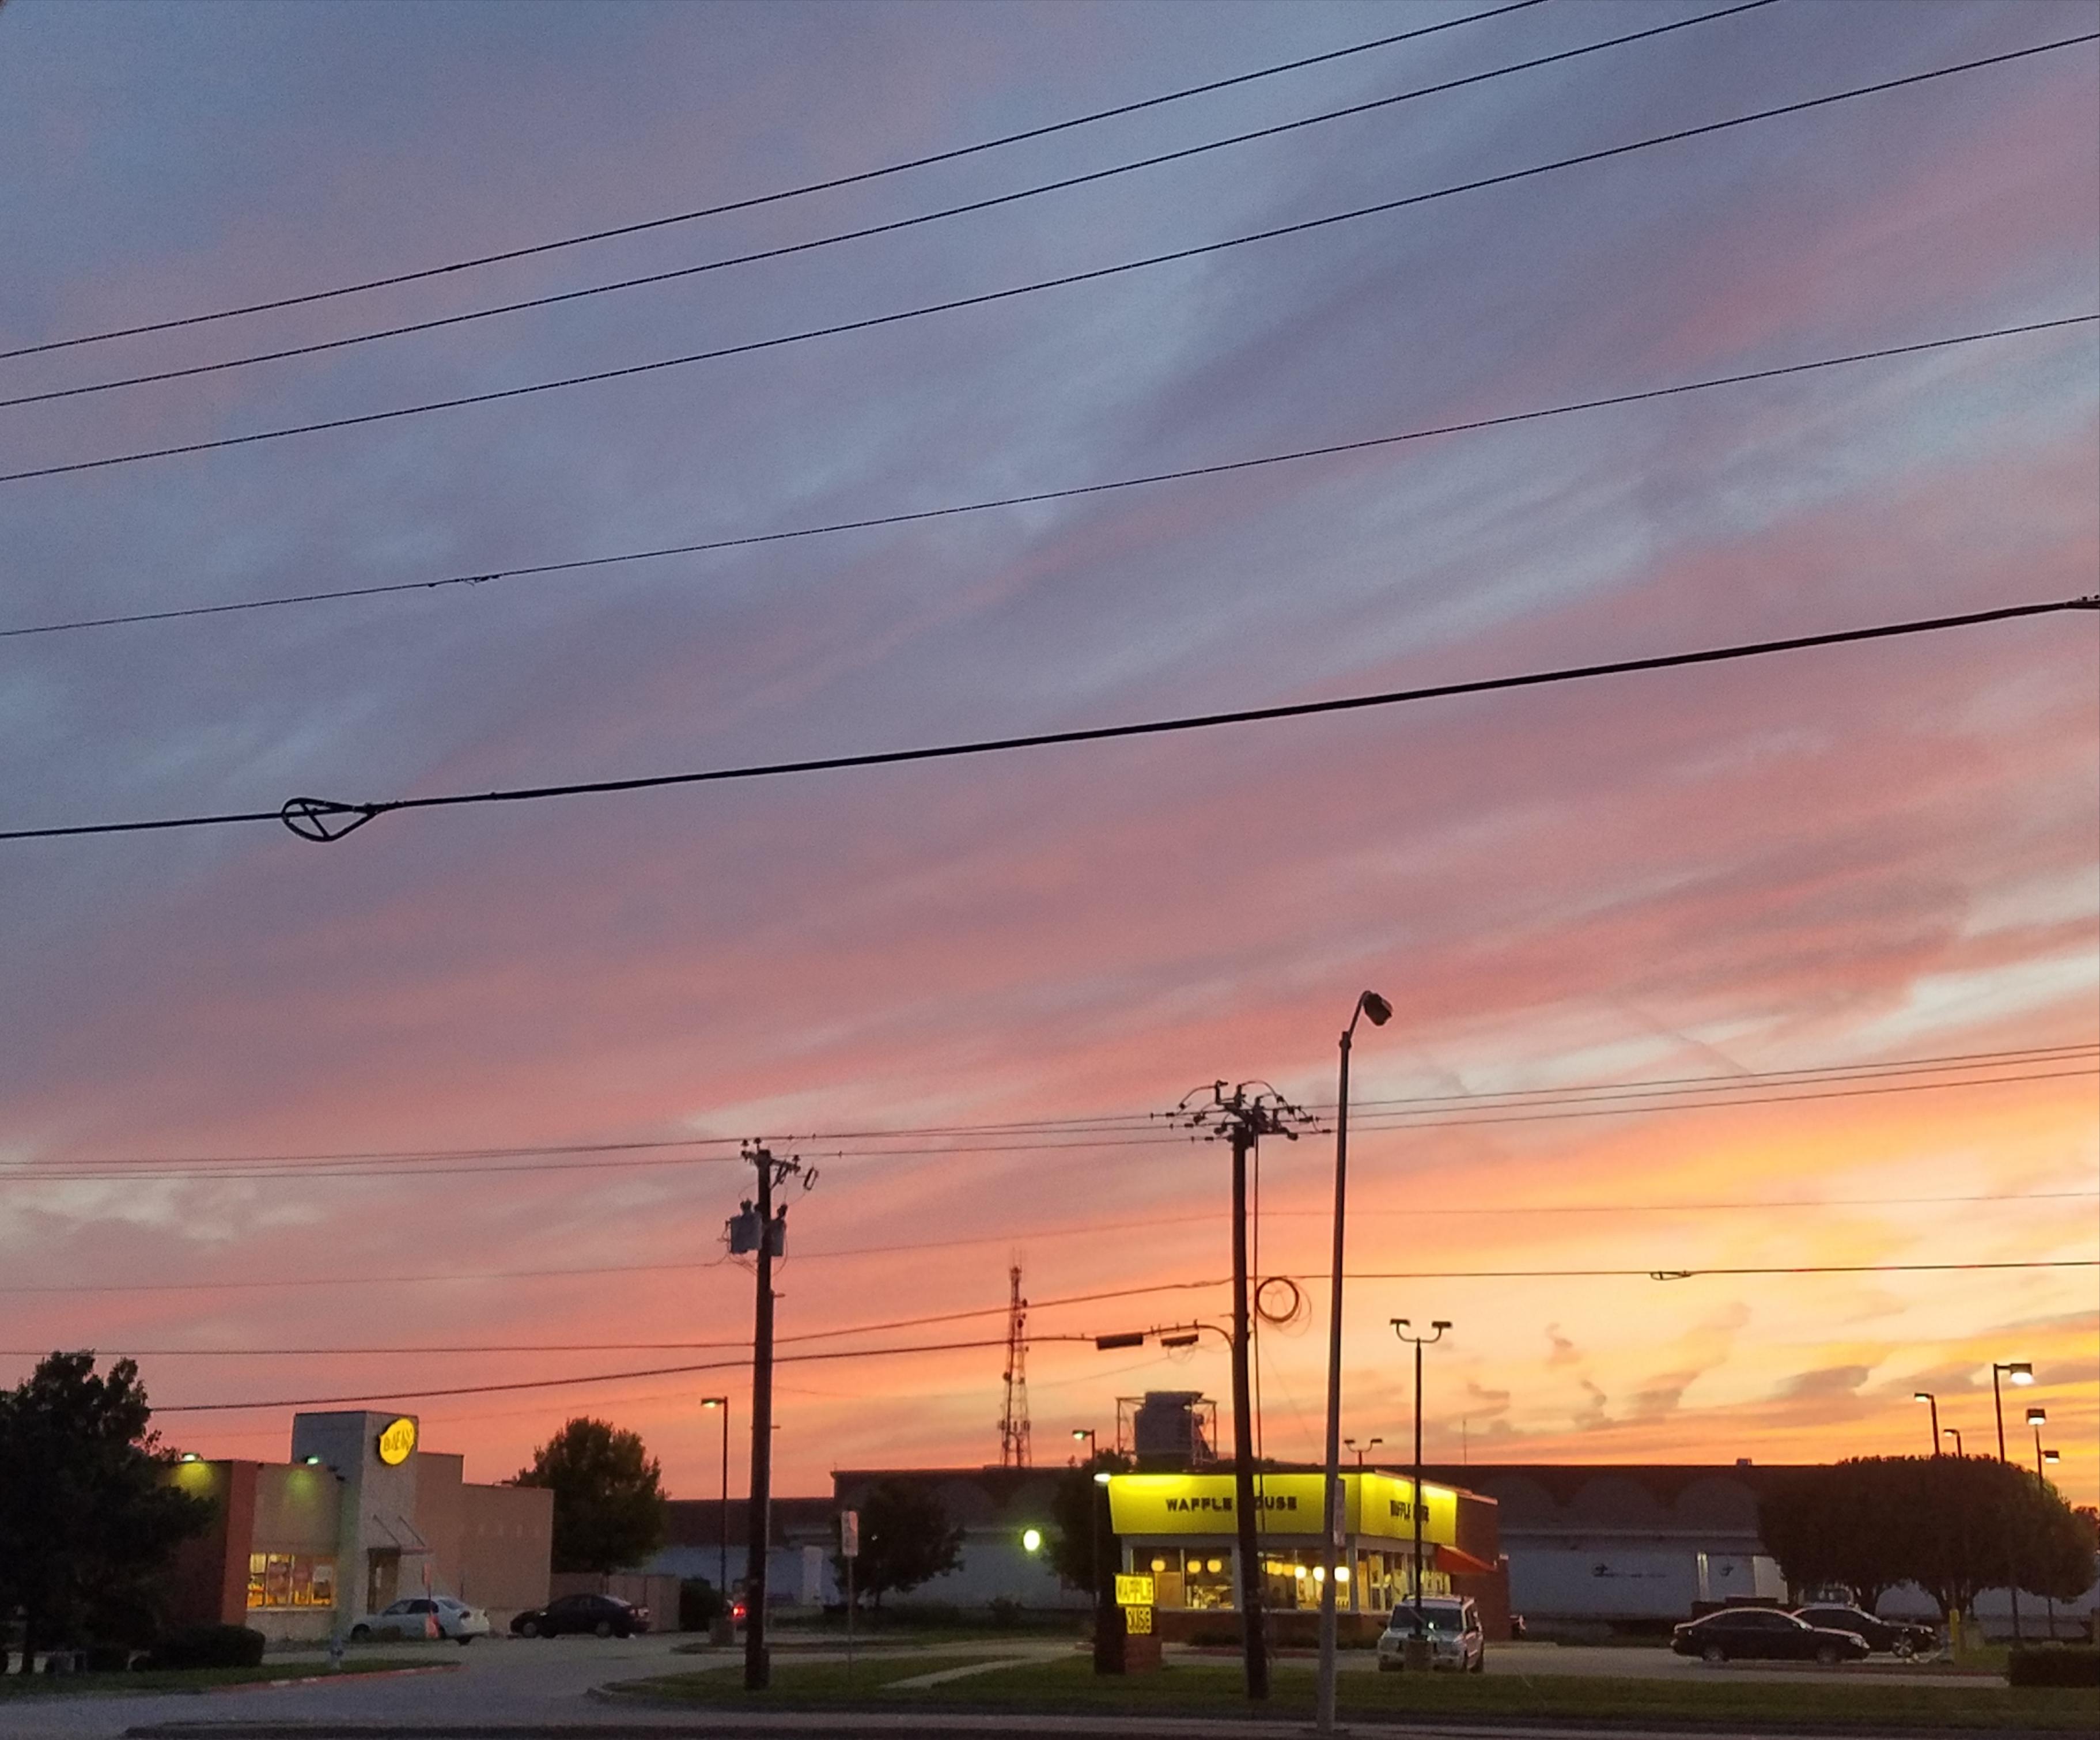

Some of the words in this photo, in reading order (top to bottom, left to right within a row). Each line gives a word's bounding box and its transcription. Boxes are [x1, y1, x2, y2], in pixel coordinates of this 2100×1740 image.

[1166, 1497, 1232, 1512] WAFFLE
[1253, 1496, 1297, 1510] OUSE
[1126, 1609, 1151, 1631] OUSE
